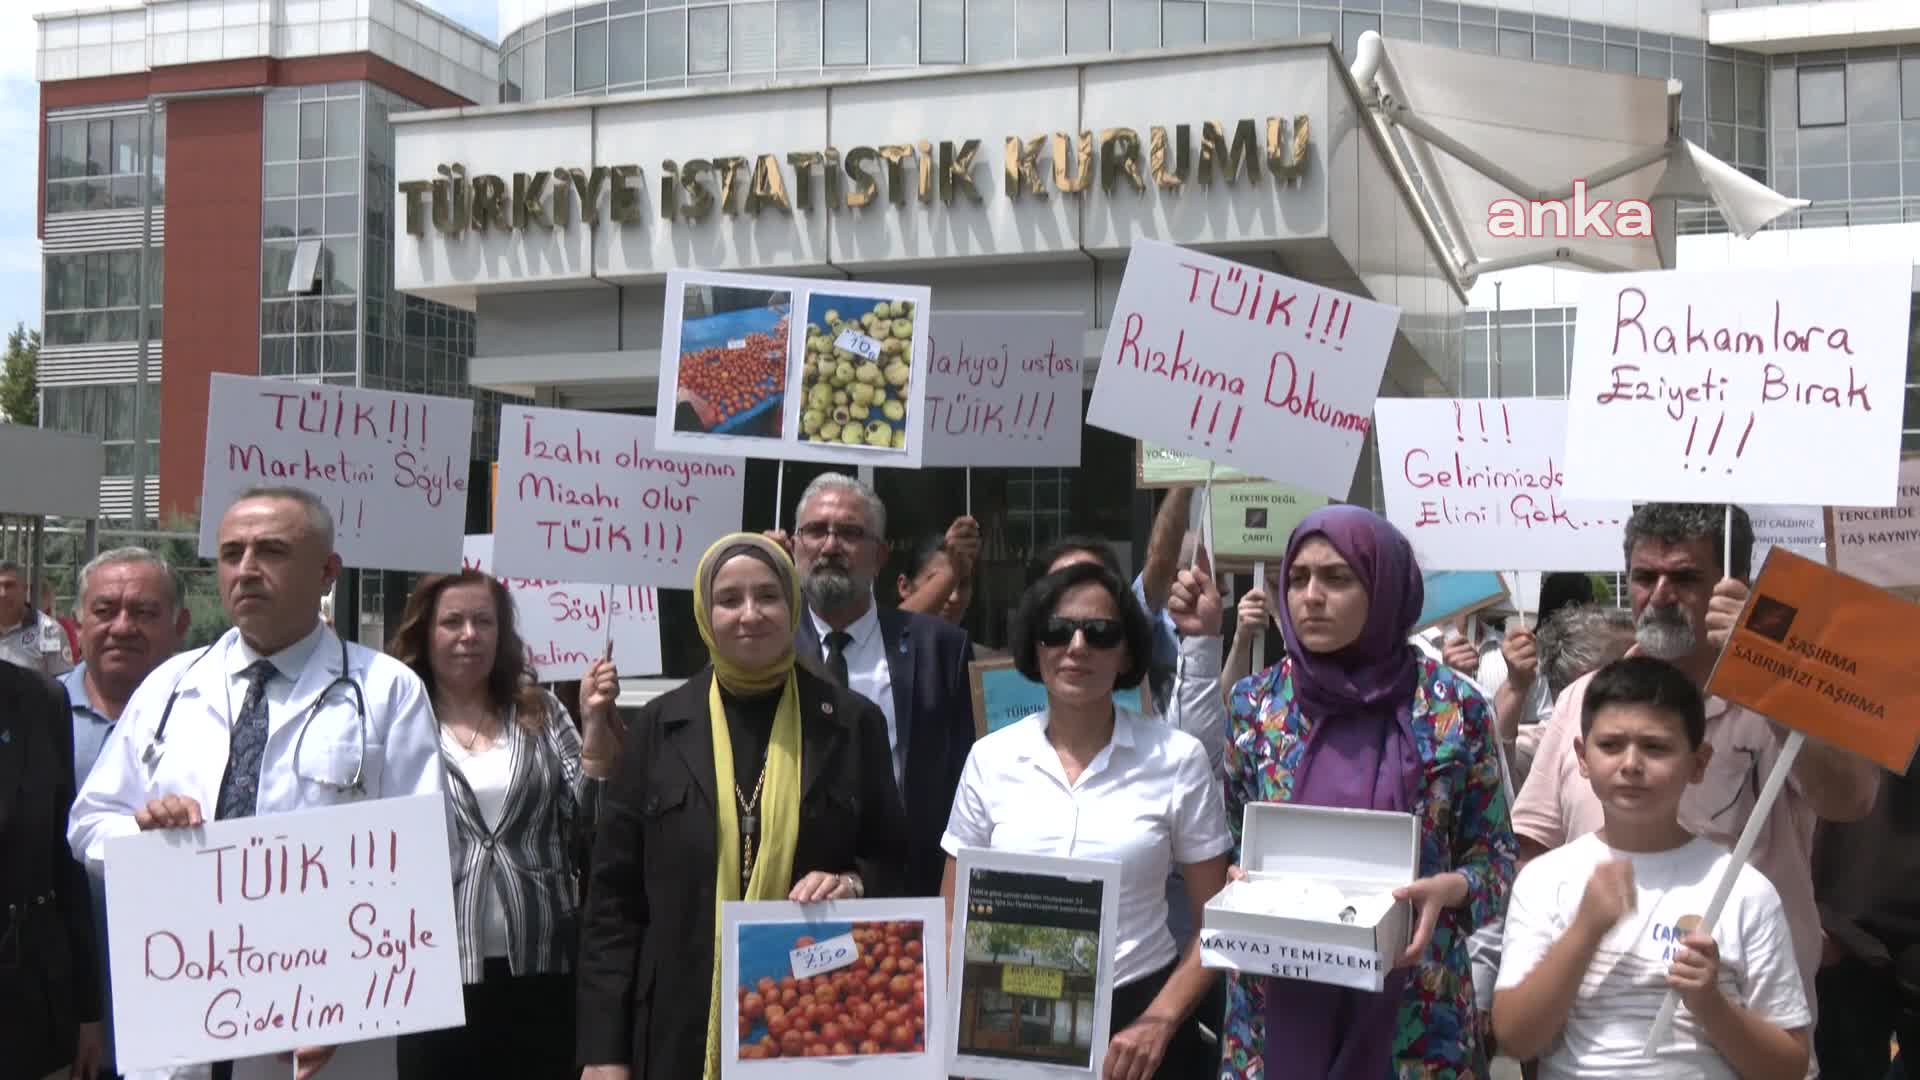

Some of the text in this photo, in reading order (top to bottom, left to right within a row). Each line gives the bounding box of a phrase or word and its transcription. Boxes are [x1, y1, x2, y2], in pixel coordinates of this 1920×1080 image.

[398, 114, 1310, 239] TÜRKİYE İSTATİSTİK KURUMU
[1612, 287, 1855, 356] Rakamlara
[1117, 312, 1245, 395] Rızkıma
[1762, 364, 1873, 411] Bırak
[393, 451, 467, 508] Söyle
[615, 440, 736, 488] olmayanın
[642, 486, 700, 514] Olur
[1415, 496, 1488, 528] Elini
[1838, 506, 1912, 522] TENCEREDE
[1868, 529, 1920, 545] KAYNIY
[144, 903, 438, 981] Doktorunu Söyle
[1199, 937, 1384, 971] MAKYAJ TEMİZLEME
[1271, 963, 1310, 979] SETİ
[204, 984, 344, 1039] Gidelim
